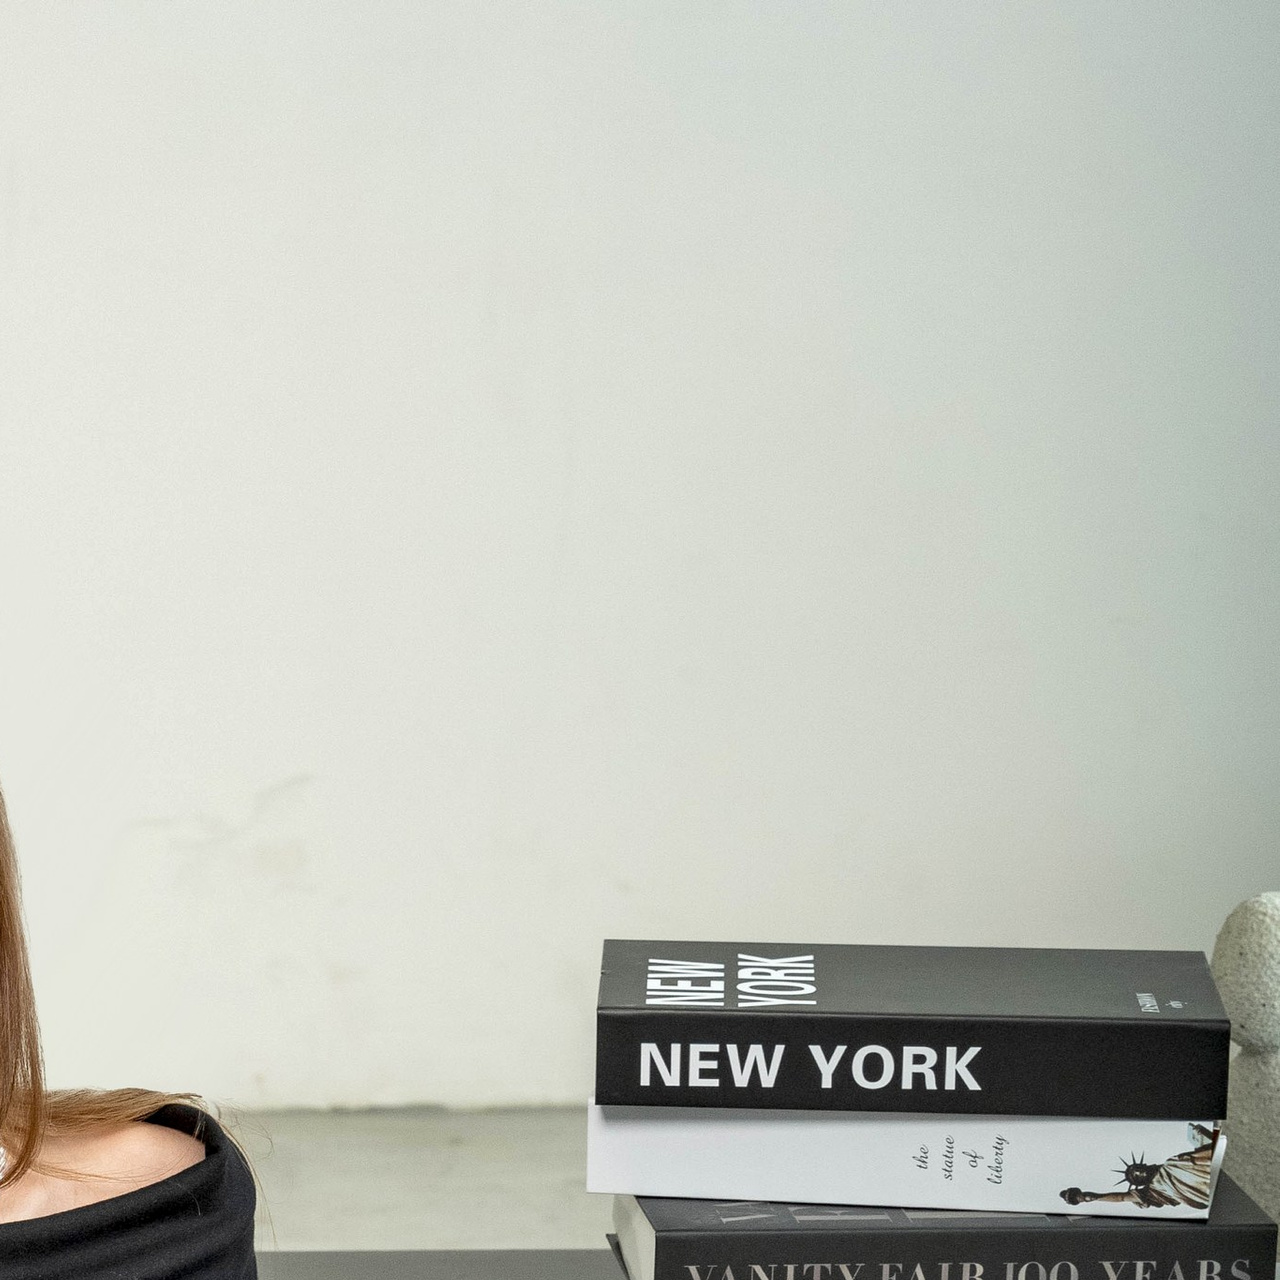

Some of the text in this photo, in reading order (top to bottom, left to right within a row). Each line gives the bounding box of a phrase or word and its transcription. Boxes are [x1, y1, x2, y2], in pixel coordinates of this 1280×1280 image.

[645, 958, 725, 1006] NEW
[736, 953, 817, 1008] YORK
[639, 1042, 983, 1091] NEW YORK
[912, 1144, 929, 1170] the
[942, 1135, 955, 1181] statue
[962, 1149, 984, 1168] of
[986, 1134, 1010, 1185] liberty
